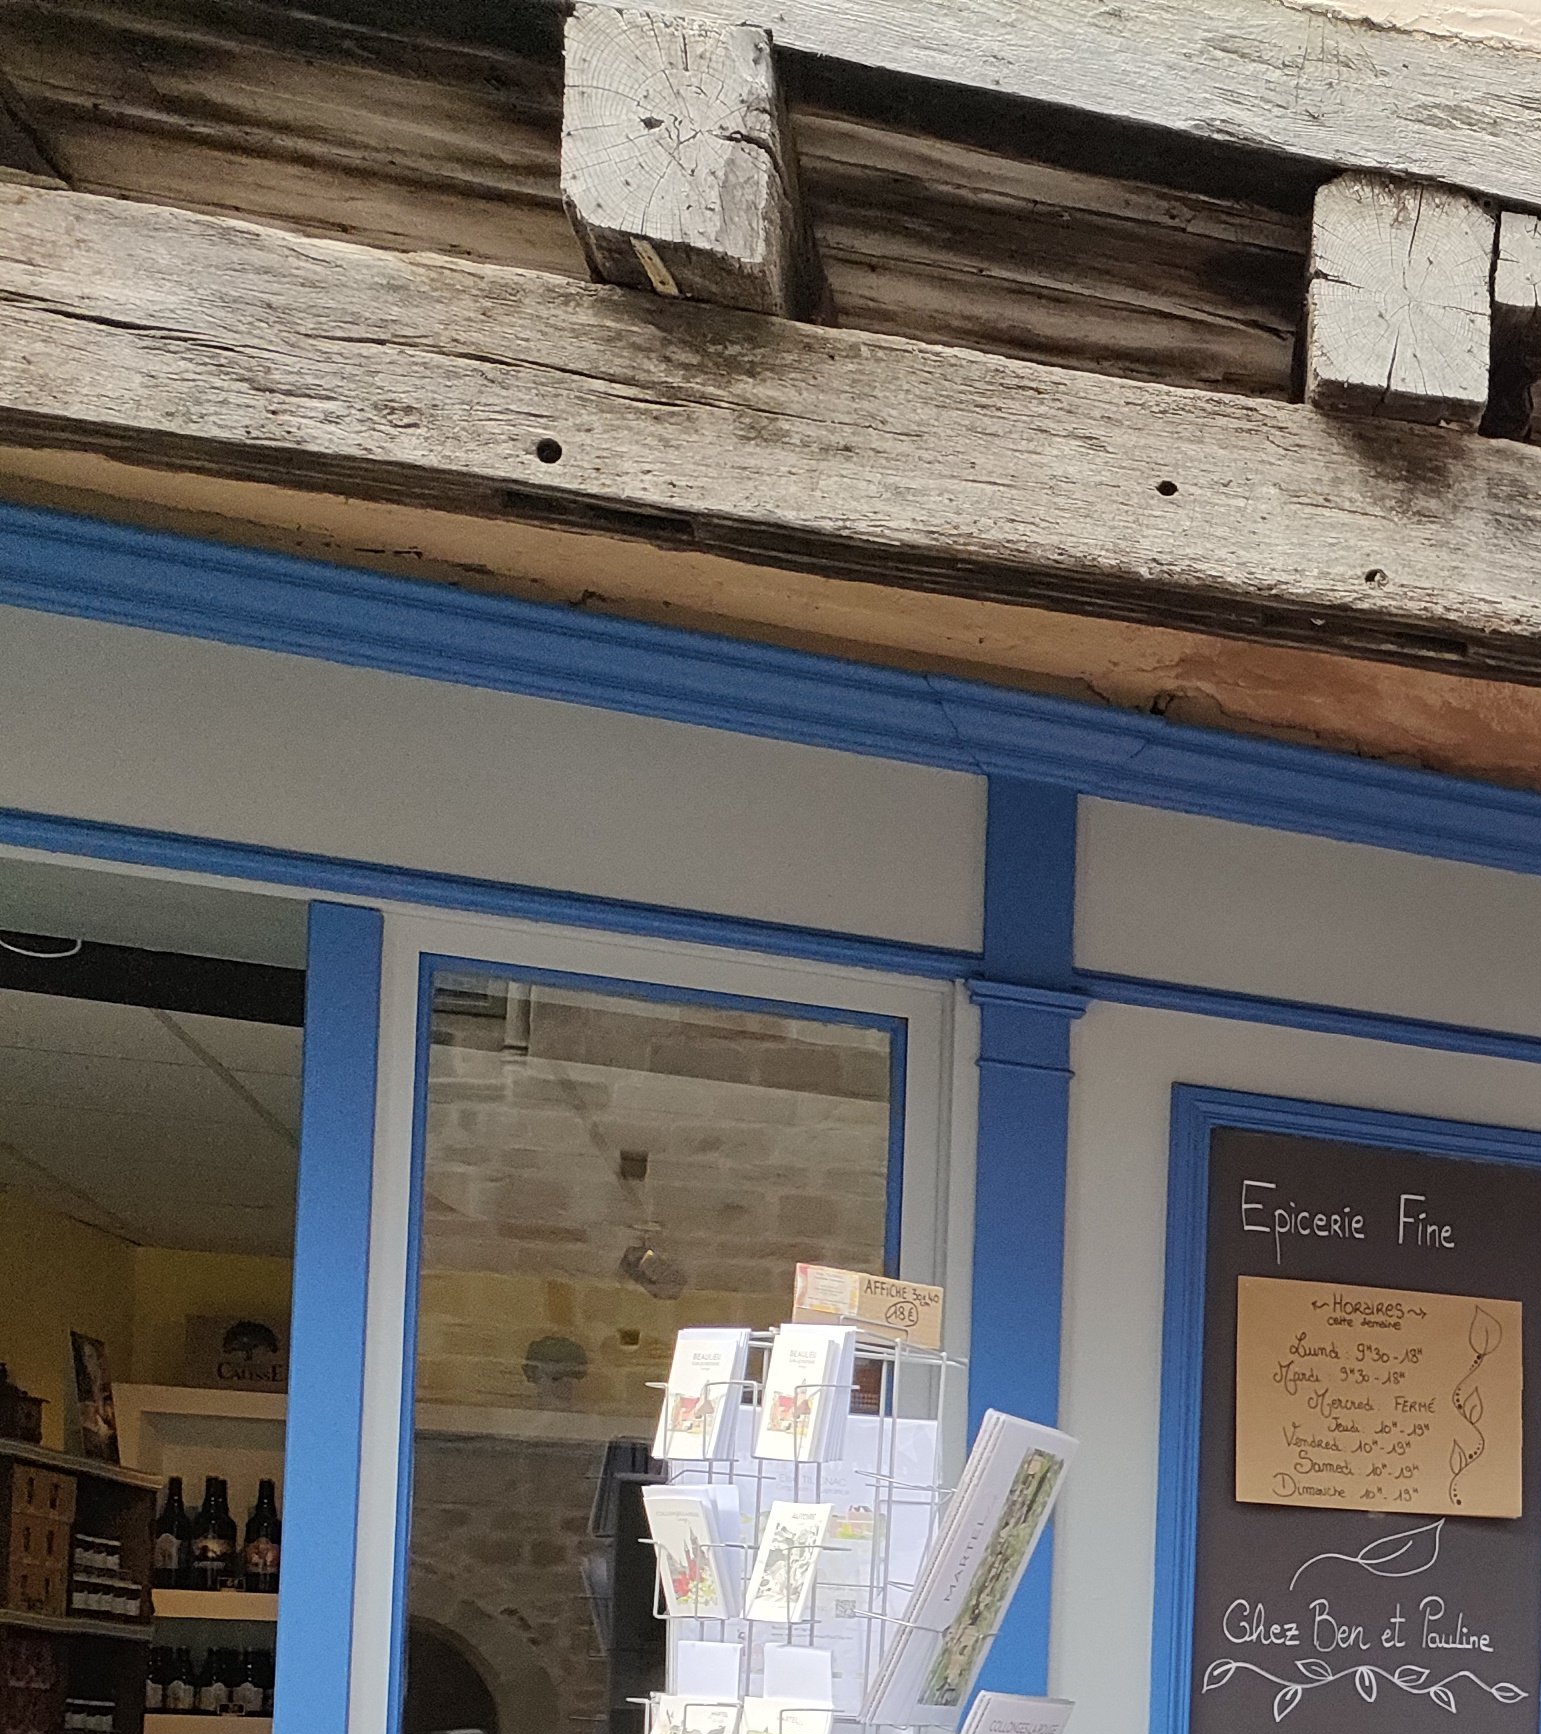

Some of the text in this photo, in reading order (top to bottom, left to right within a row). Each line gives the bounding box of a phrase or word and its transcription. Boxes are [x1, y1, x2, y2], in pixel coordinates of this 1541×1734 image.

[1241, 1179, 1455, 1265] Epicerie Fine
[1394, 1395, 1437, 1414] FERMÉ
[1222, 1595, 1495, 1652] Chez Ben et Pauline
